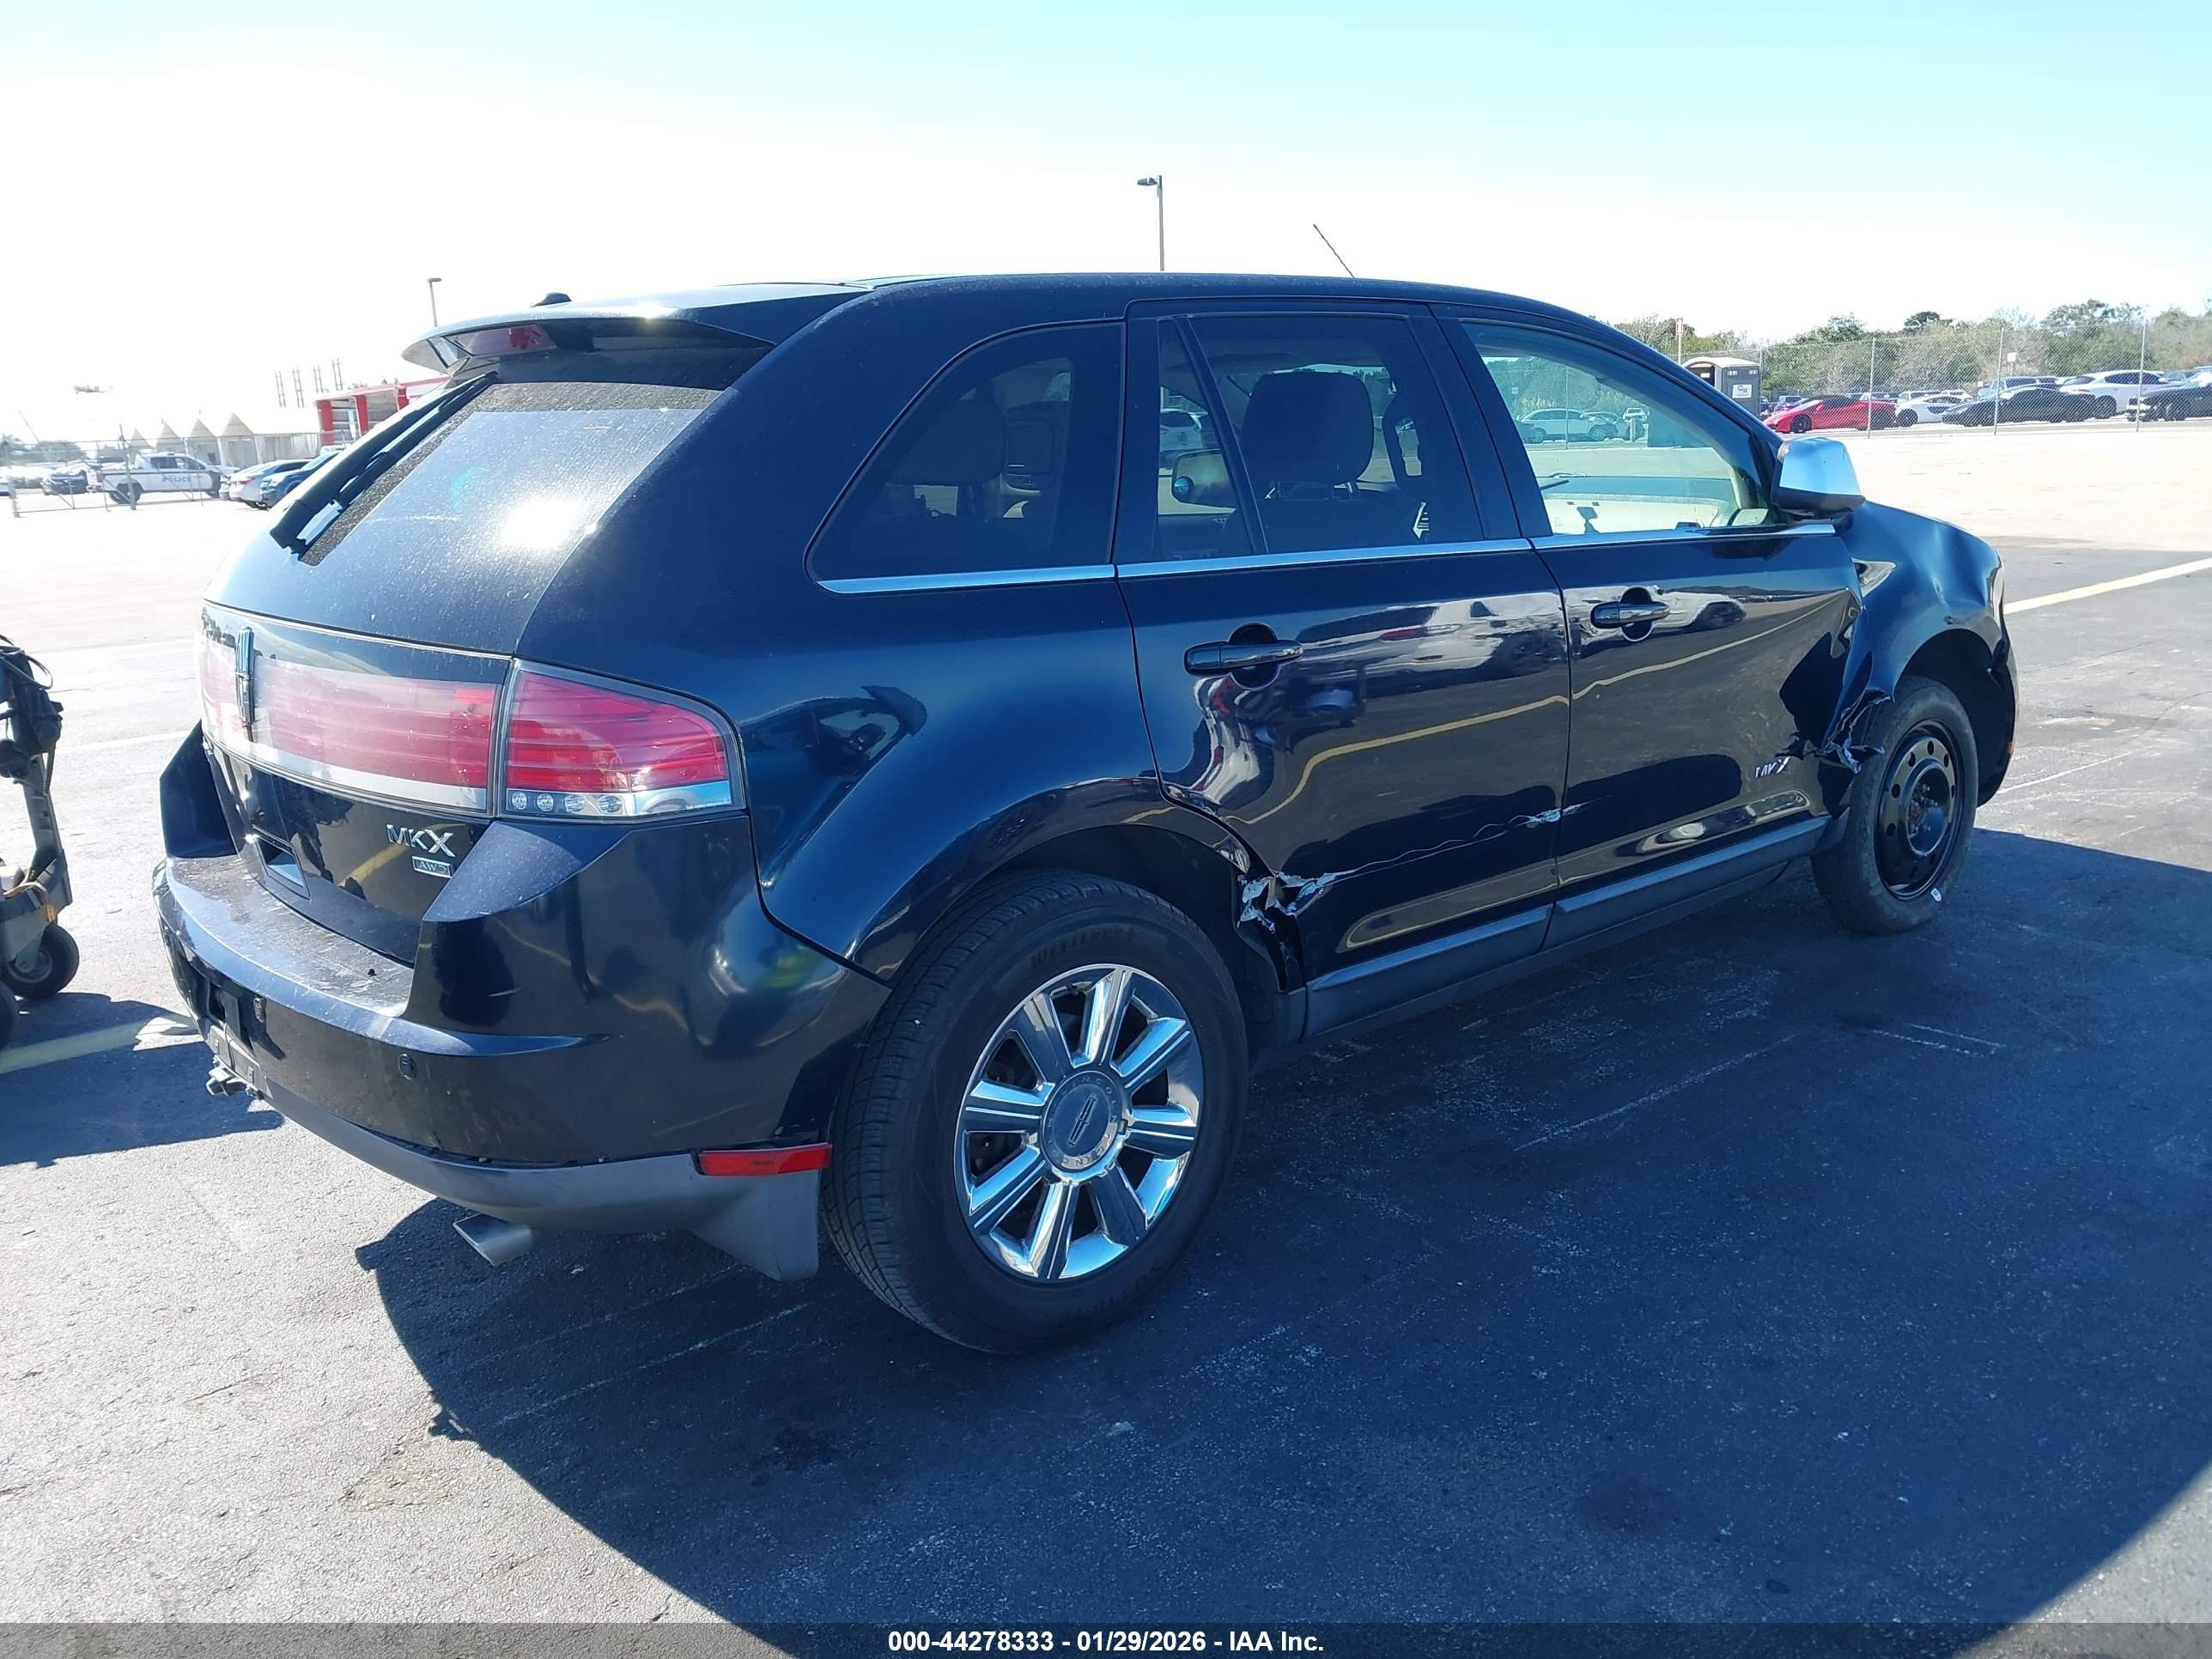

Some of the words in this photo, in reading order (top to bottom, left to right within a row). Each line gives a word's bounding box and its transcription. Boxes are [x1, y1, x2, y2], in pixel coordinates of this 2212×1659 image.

[161, 473, 191, 483] POLICE
[386, 823, 456, 857] MKX
[417, 861, 447, 873] AWD
